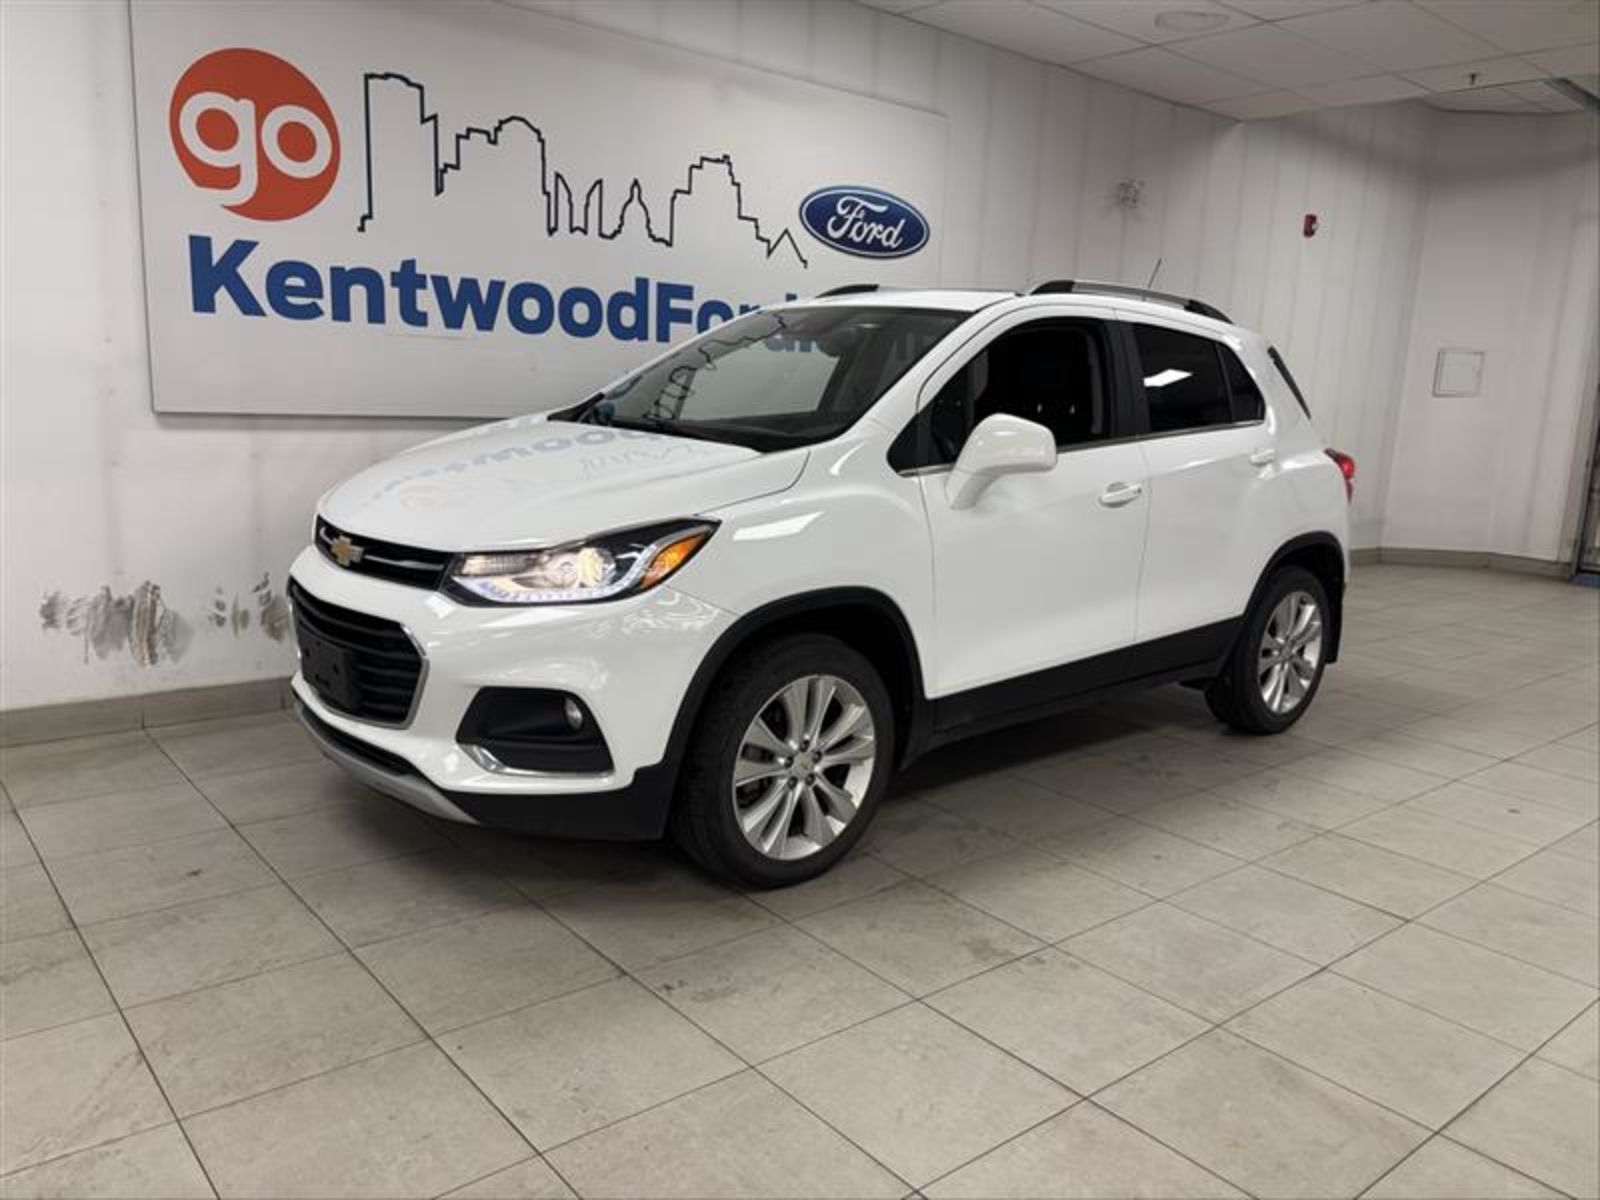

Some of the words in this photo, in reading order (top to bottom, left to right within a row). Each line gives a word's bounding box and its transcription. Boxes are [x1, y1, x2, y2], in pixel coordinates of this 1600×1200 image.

[179, 91, 332, 207] go
[827, 196, 905, 248] Ford
[188, 234, 798, 344] KentwoodFo
